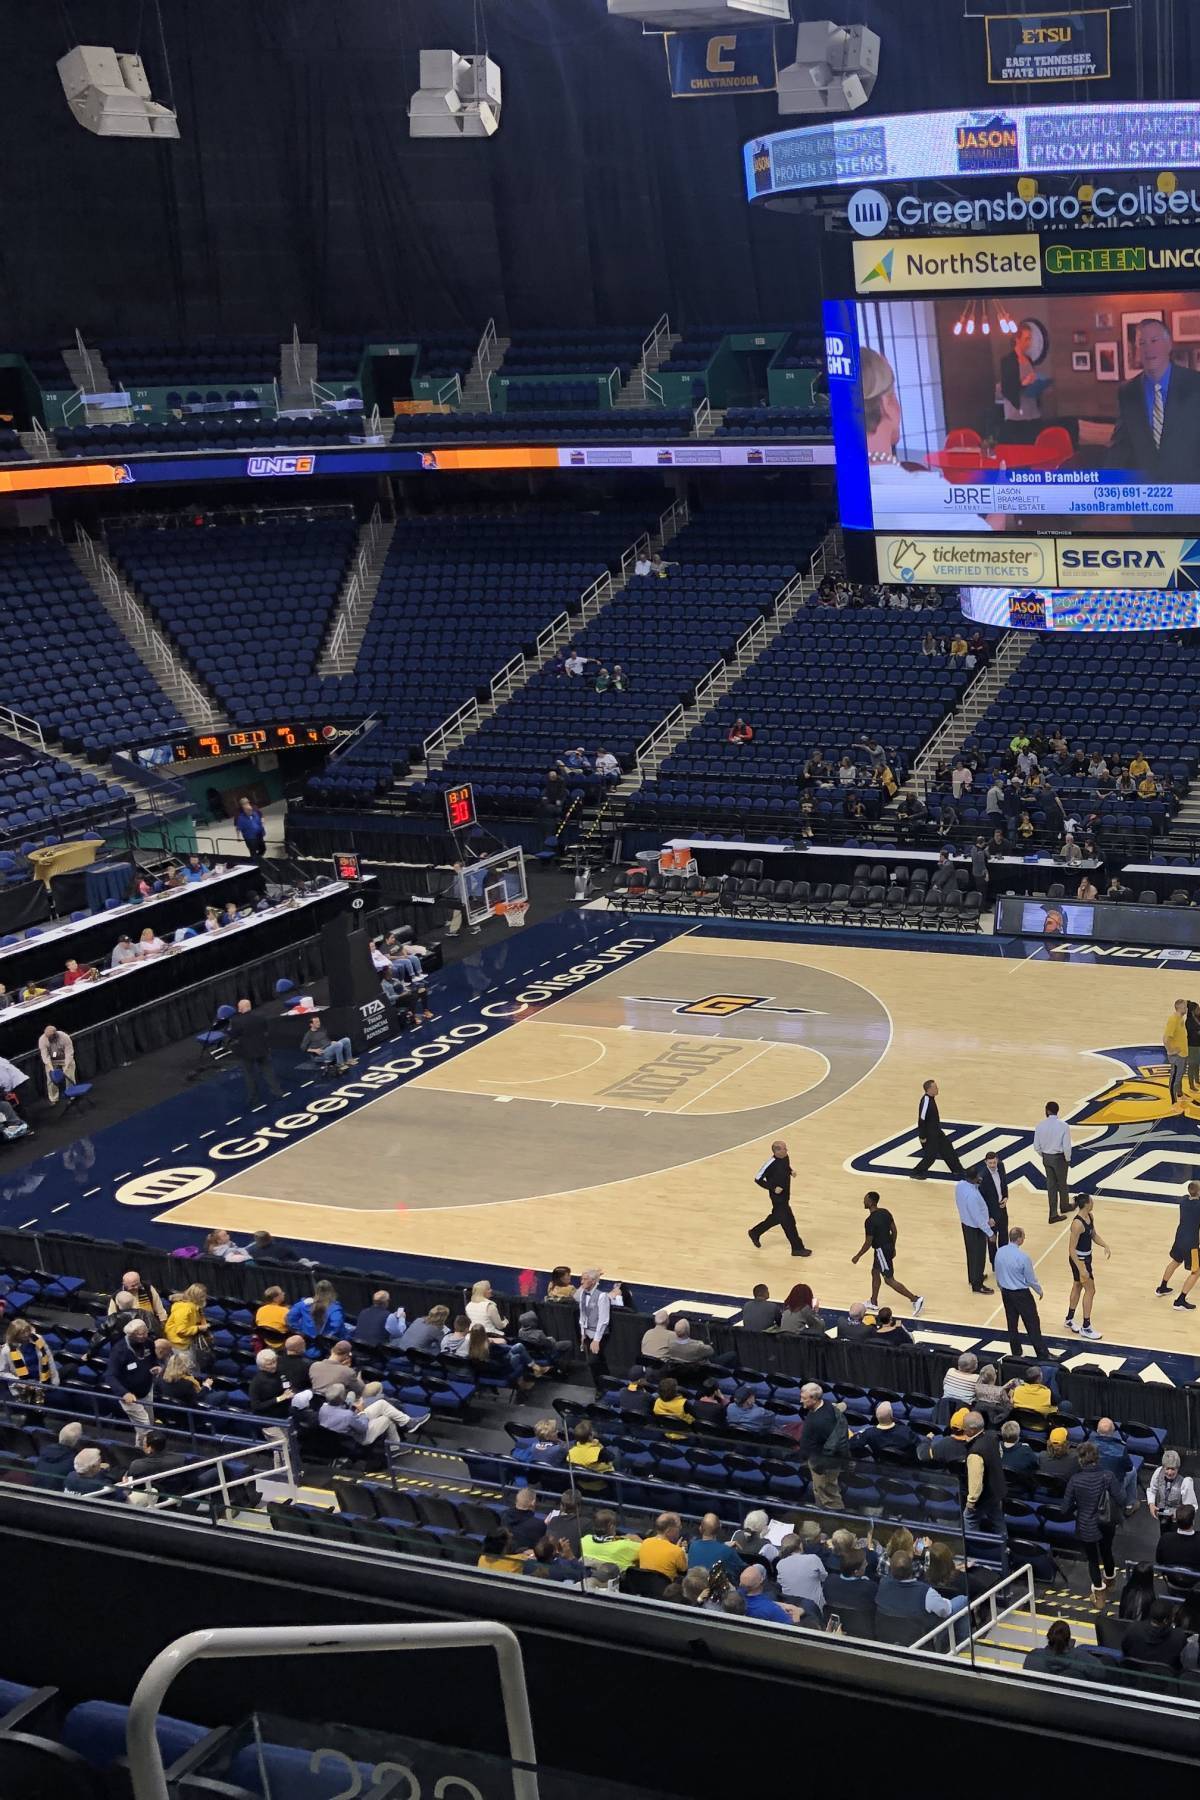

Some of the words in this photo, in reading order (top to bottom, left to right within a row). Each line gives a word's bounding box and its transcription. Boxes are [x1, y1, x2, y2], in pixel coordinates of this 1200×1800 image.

[1022, 26, 1071, 44] ETSU
[1006, 57, 1032, 67] EAST
[1034, 53, 1092, 66] TENNESSEE
[1001, 69, 1034, 79] STATE
[1037, 65, 1096, 77] UNIVERSITY
[690, 75, 759, 89] CHATTANOOGA
[957, 127, 1017, 150] JASON
[1031, 142, 1121, 162] PROVEN
[775, 162, 816, 182] PROVEN
[820, 156, 884, 178] SYSTEMS
[896, 192, 1080, 225] Greensboro
[907, 250, 1037, 277] NorthState
[1046, 245, 1147, 274] GREEN
[248, 455, 316, 476] UNCG
[1009, 471, 1041, 483] Jason
[1045, 471, 1099, 483] Bramblett
[944, 487, 992, 504] JBRE
[1093, 487, 1121, 500] (336)
[1122, 487, 1173, 498] 691-2222
[1019, 503, 1046, 511] ESTATE
[1069, 501, 1174, 512] JasonBramblett.com
[932, 545, 1032, 564] ticketmaster
[1062, 549, 1166, 568] SEGRA
[933, 564, 981, 577] VERIFIED
[983, 563, 1029, 576] TICKETS
[1009, 598, 1044, 614] JASON
[1058, 612, 1112, 625] PROVEN
[1117, 611, 1195, 624] SYSTEMS
[233, 729, 266, 745] 13:17
[288, 733, 295, 745] 0
[309, 732, 317, 741] 4
[338, 730, 360, 738] pepsi
[179, 749, 186, 758] 4
[211, 744, 219, 755] 0
[450, 801, 469, 824] 30
[359, 999, 386, 1017] TFA
[363, 1018, 389, 1034] FINANCIAL
[367, 1014, 383, 1024] TRIAD
[366, 1025, 390, 1041] ADVISORS
[208, 1022, 486, 1161] Greensboro
[481, 937, 656, 1019] Coliseum
